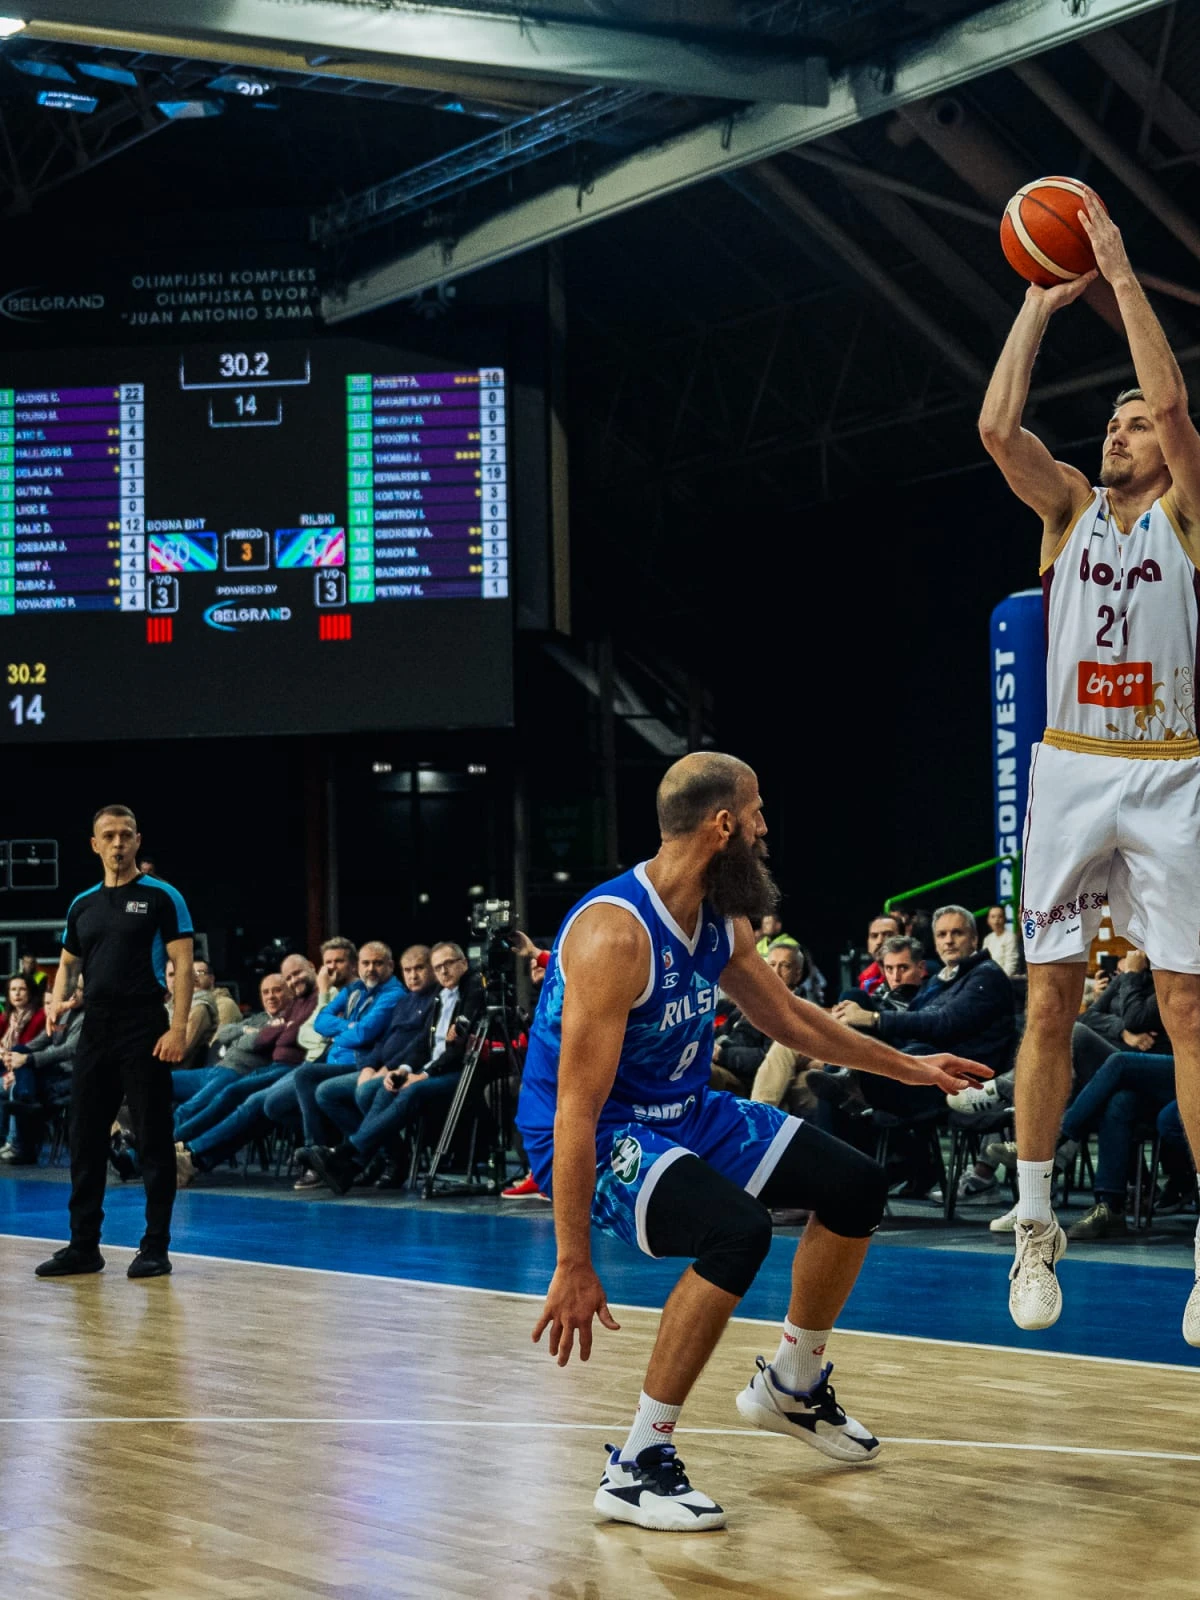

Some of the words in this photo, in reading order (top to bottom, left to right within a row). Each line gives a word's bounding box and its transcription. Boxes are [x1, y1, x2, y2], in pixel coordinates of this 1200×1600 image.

[132, 272, 224, 289] OLIMPIJSKI
[230, 267, 317, 285] KOMPLEKS
[8, 294, 105, 312] BELGRAND
[156, 288, 255, 306] OLIMPIJSKA
[180, 306, 259, 323] ANTONIO
[219, 352, 270, 377] 30.2
[126, 387, 140, 400] 22
[488, 392, 497, 403] 0
[128, 406, 136, 417] 0
[235, 395, 258, 416] 14
[488, 411, 497, 422] 0
[128, 425, 136, 435] 4
[489, 430, 497, 441] 5
[128, 444, 136, 455] 6
[489, 449, 498, 461] 2
[129, 462, 135, 473] 1
[486, 467, 500, 479] 19
[128, 481, 136, 493] 3
[490, 486, 499, 498] 3
[129, 500, 137, 512] 0
[490, 505, 499, 517] 0
[126, 518, 140, 531] 12
[300, 513, 335, 525] RILSKI
[147, 519, 182, 532] BOSNA
[490, 525, 499, 536] 0
[230, 529, 263, 540] PERIOD
[129, 539, 137, 549] 4
[303, 535, 332, 559] 47
[163, 541, 190, 564] 60
[241, 542, 253, 561] 3
[129, 557, 137, 568] 4
[491, 561, 499, 573] 2
[129, 575, 137, 587] 0
[216, 586, 263, 596] POWERED
[265, 585, 278, 594] BY
[325, 581, 338, 601] 3
[354, 585, 370, 599] 77
[375, 585, 413, 598] PETROV
[492, 582, 498, 594] 1
[16, 596, 66, 609] KOVACEVIC
[129, 595, 137, 606] 4
[156, 587, 169, 607] 3
[213, 607, 292, 623] BELGRAND
[7, 662, 46, 684] 30.2
[9, 694, 45, 725] 14
[659, 984, 719, 1032] RILS
